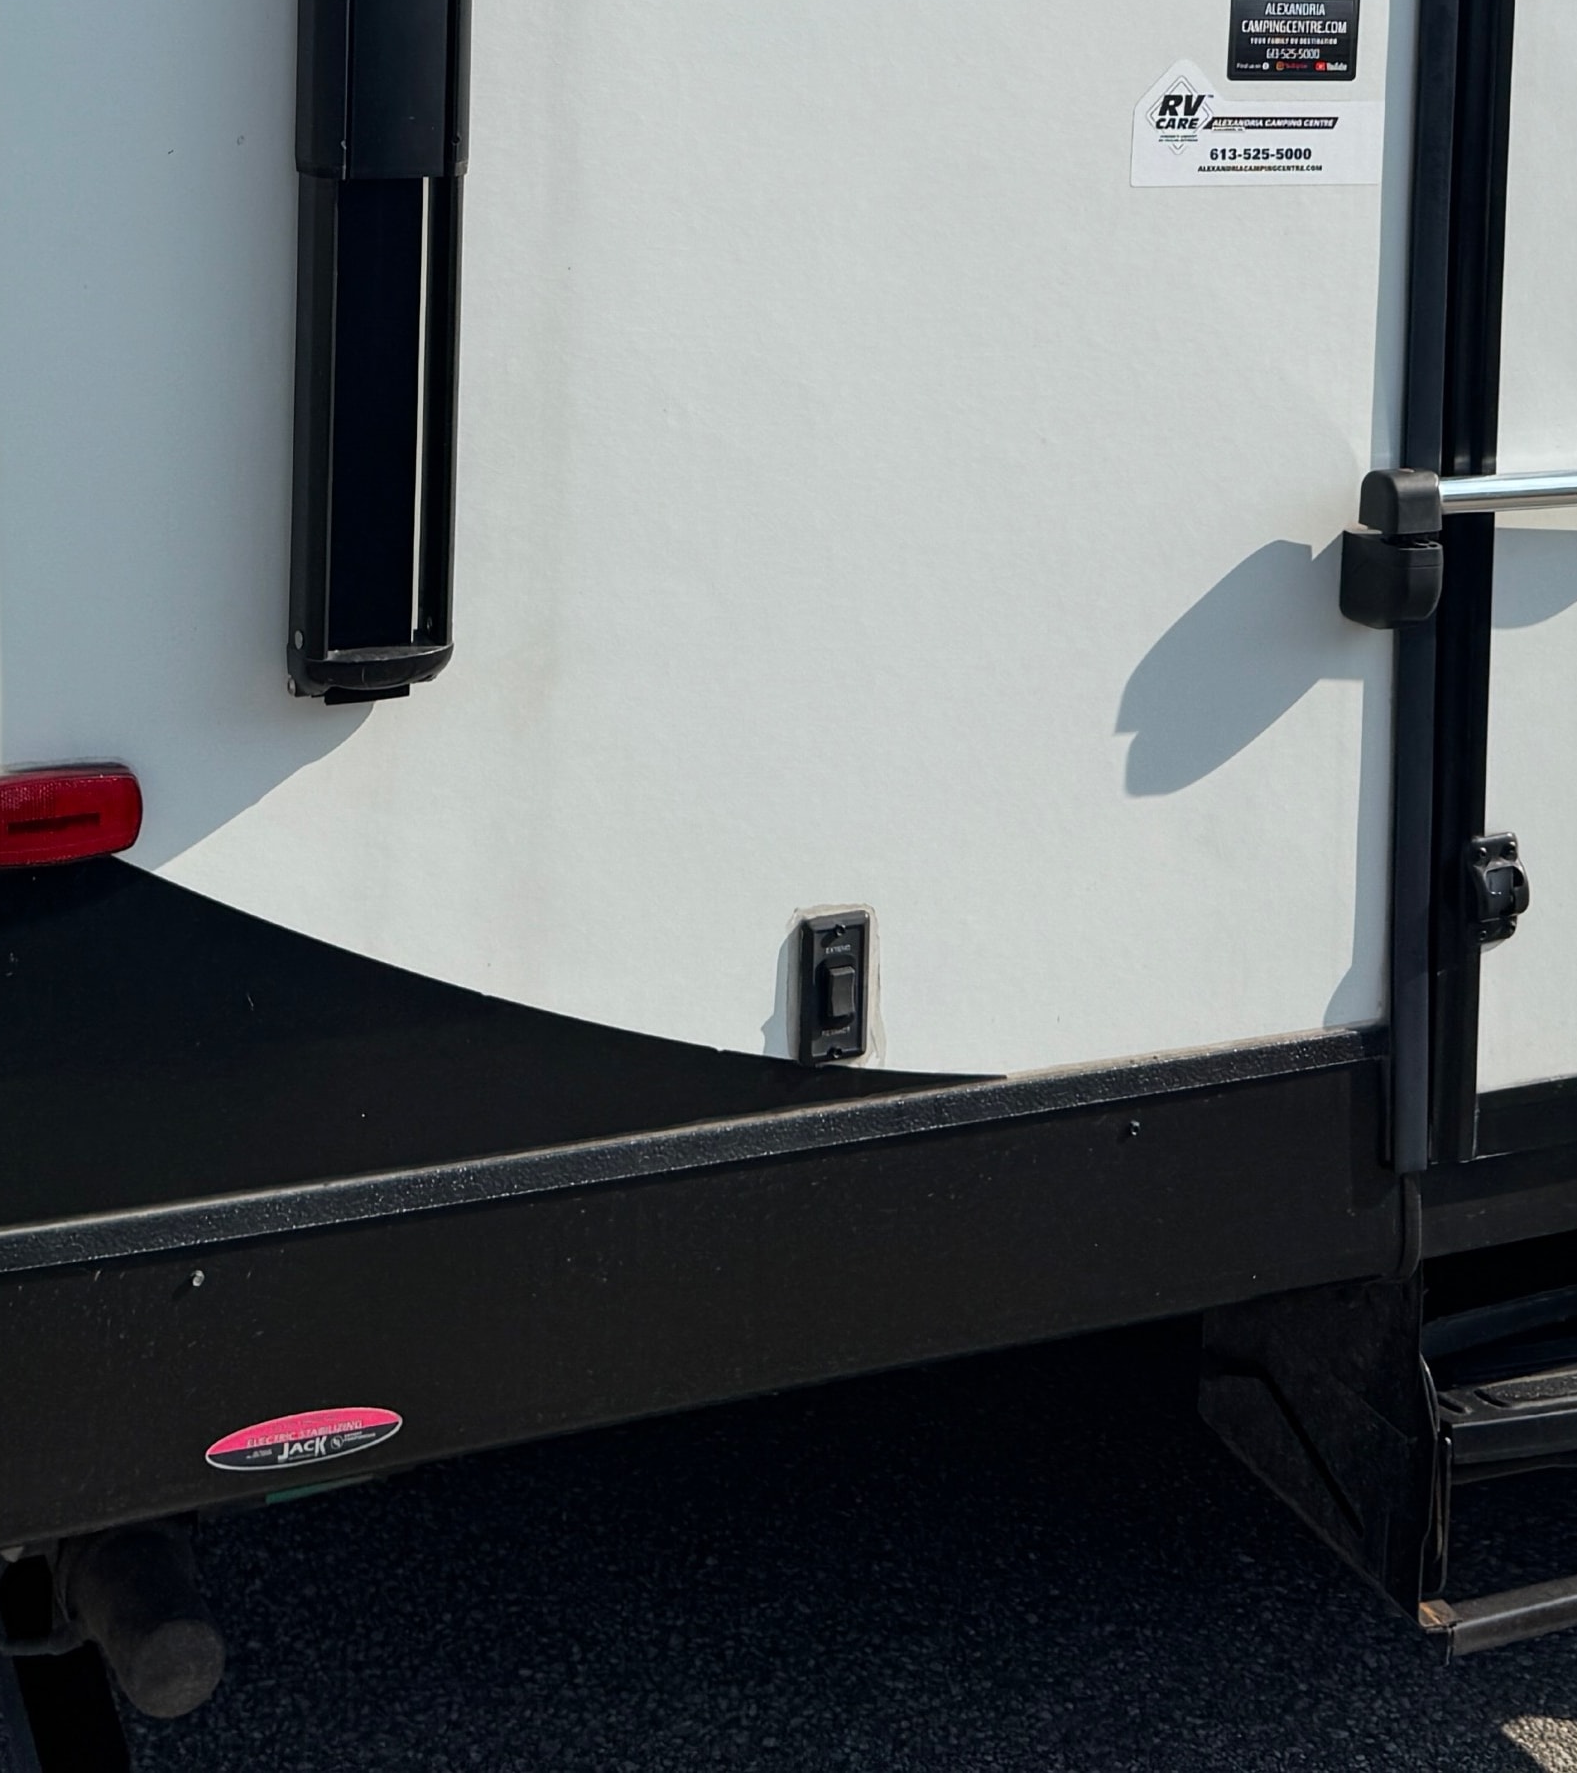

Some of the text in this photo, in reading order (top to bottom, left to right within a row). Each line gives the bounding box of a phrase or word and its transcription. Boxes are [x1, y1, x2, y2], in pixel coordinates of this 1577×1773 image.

[1265, 2, 1326, 16] ALEXANDRIA
[1241, 20, 1347, 34] CAMPINGCENTRE.COM
[1158, 94, 1206, 116] RV
[1155, 118, 1200, 130] CARE
[1211, 118, 1334, 128] ALEXANDRIA CAMPING CENTRE
[1210, 148, 1312, 160] 613-525-5000
[246, 1432, 296, 1448] ELECTRIC
[298, 1420, 362, 1439] STABILIZING
[277, 1436, 328, 1463] JACK
